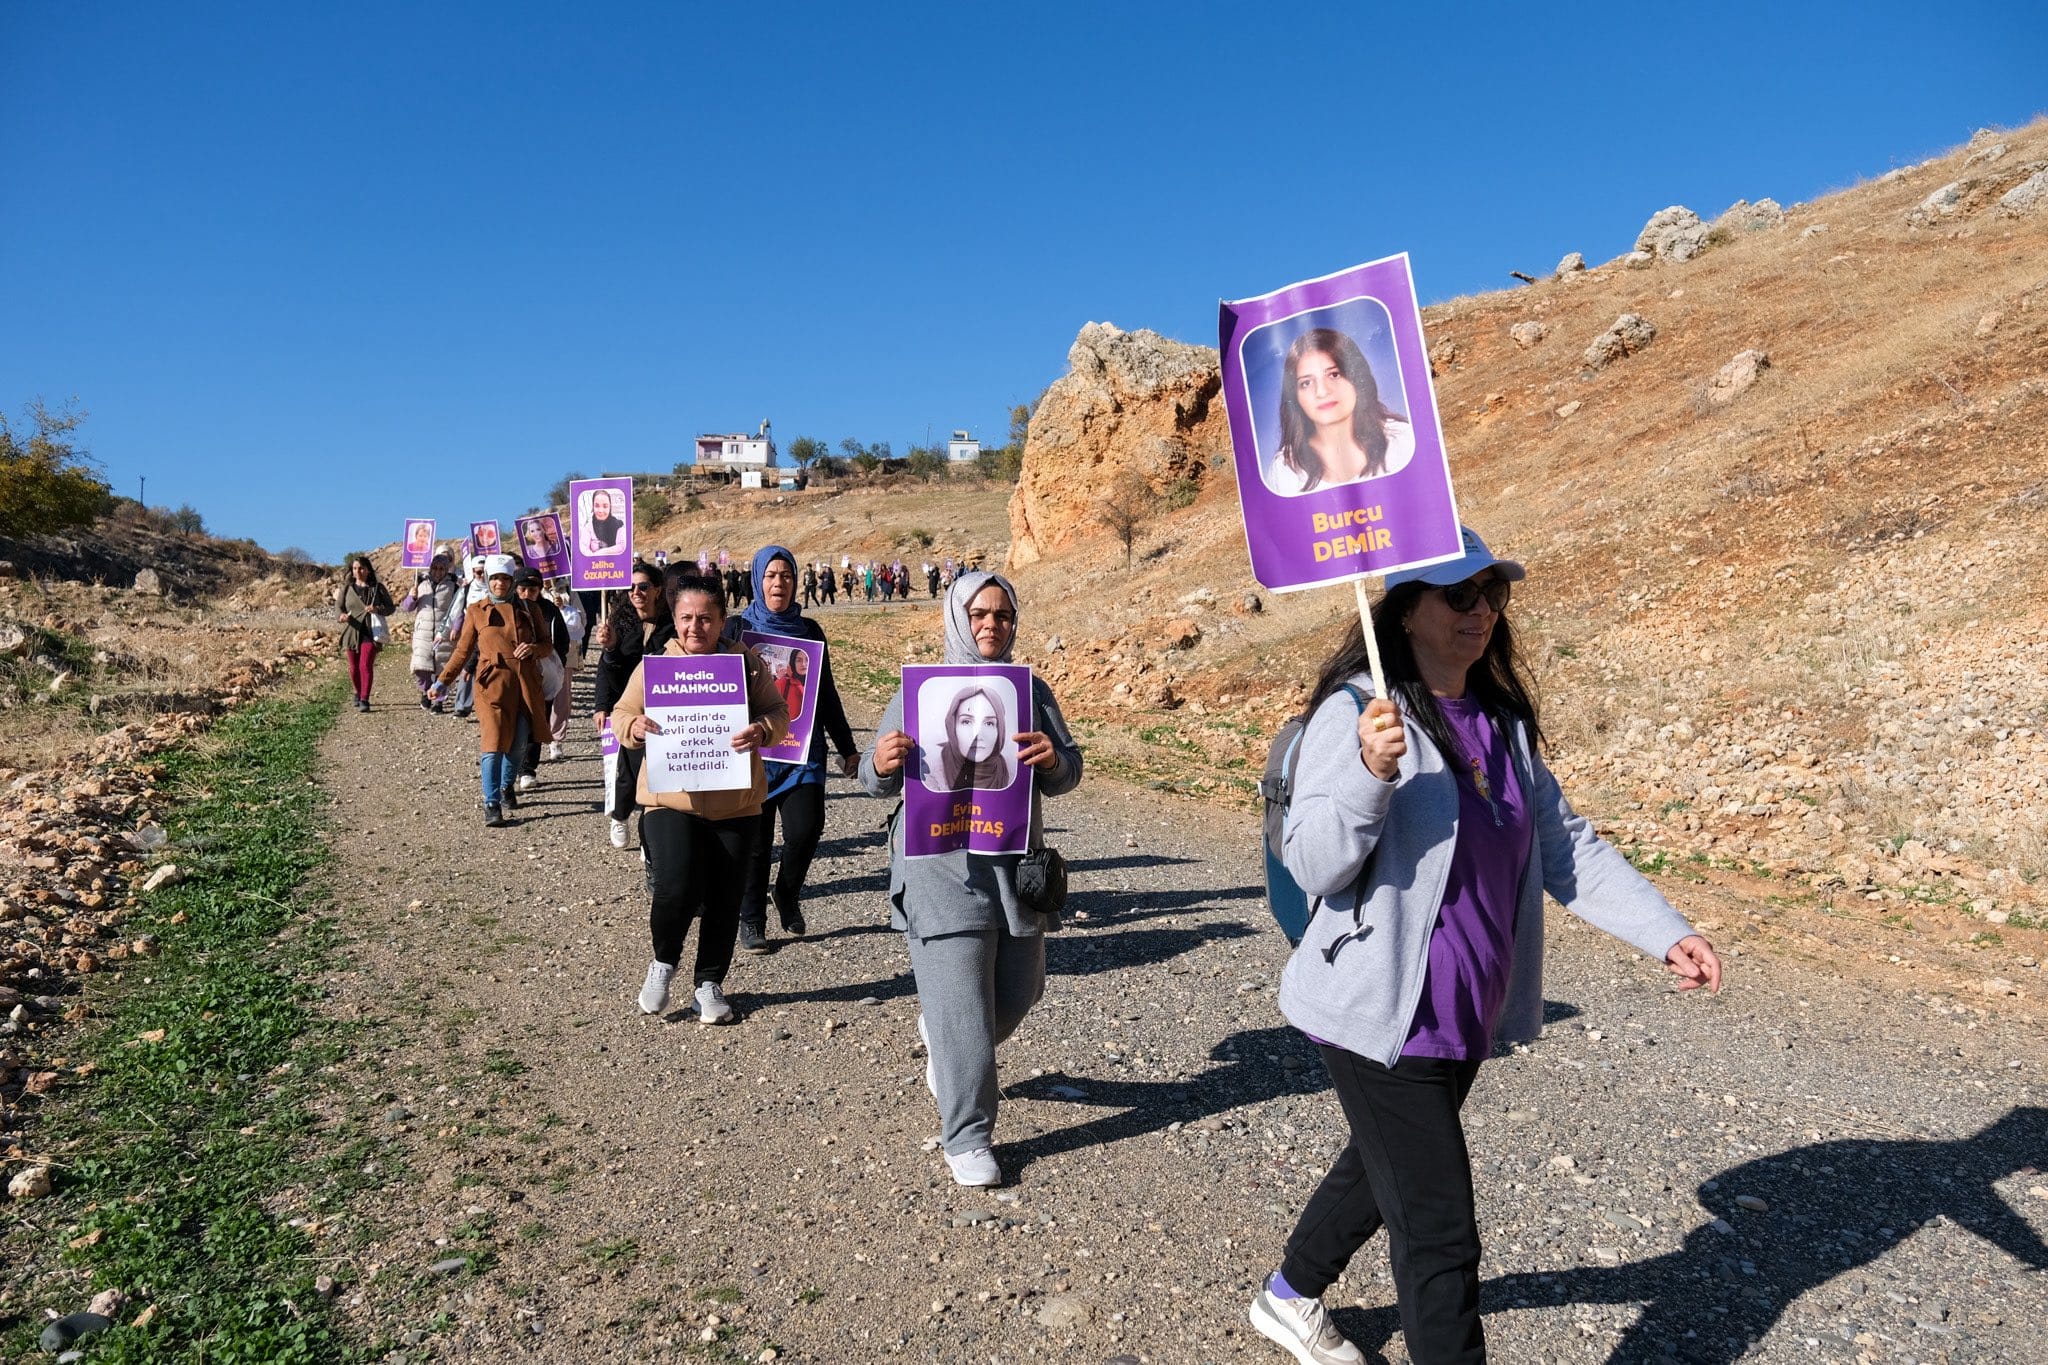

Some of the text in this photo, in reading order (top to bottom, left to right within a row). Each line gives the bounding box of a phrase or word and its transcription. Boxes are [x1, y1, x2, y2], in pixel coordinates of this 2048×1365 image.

[1312, 505, 1383, 534] Burcu
[1313, 526, 1393, 562] DEMİR
[591, 560, 615, 569] Zeliha
[583, 569, 624, 580] ÖZKAPLAN
[674, 670, 714, 681] Media
[651, 683, 738, 695] ALMAHMOUD
[667, 712, 726, 723] Mardin'de
[664, 724, 730, 736] evli olduğu
[680, 737, 715, 747] erkek
[666, 749, 729, 760] tarafından
[668, 760, 728, 772] katledildi.
[953, 802, 982, 816] Evin
[930, 817, 1004, 837] DEMİRTAŞ
